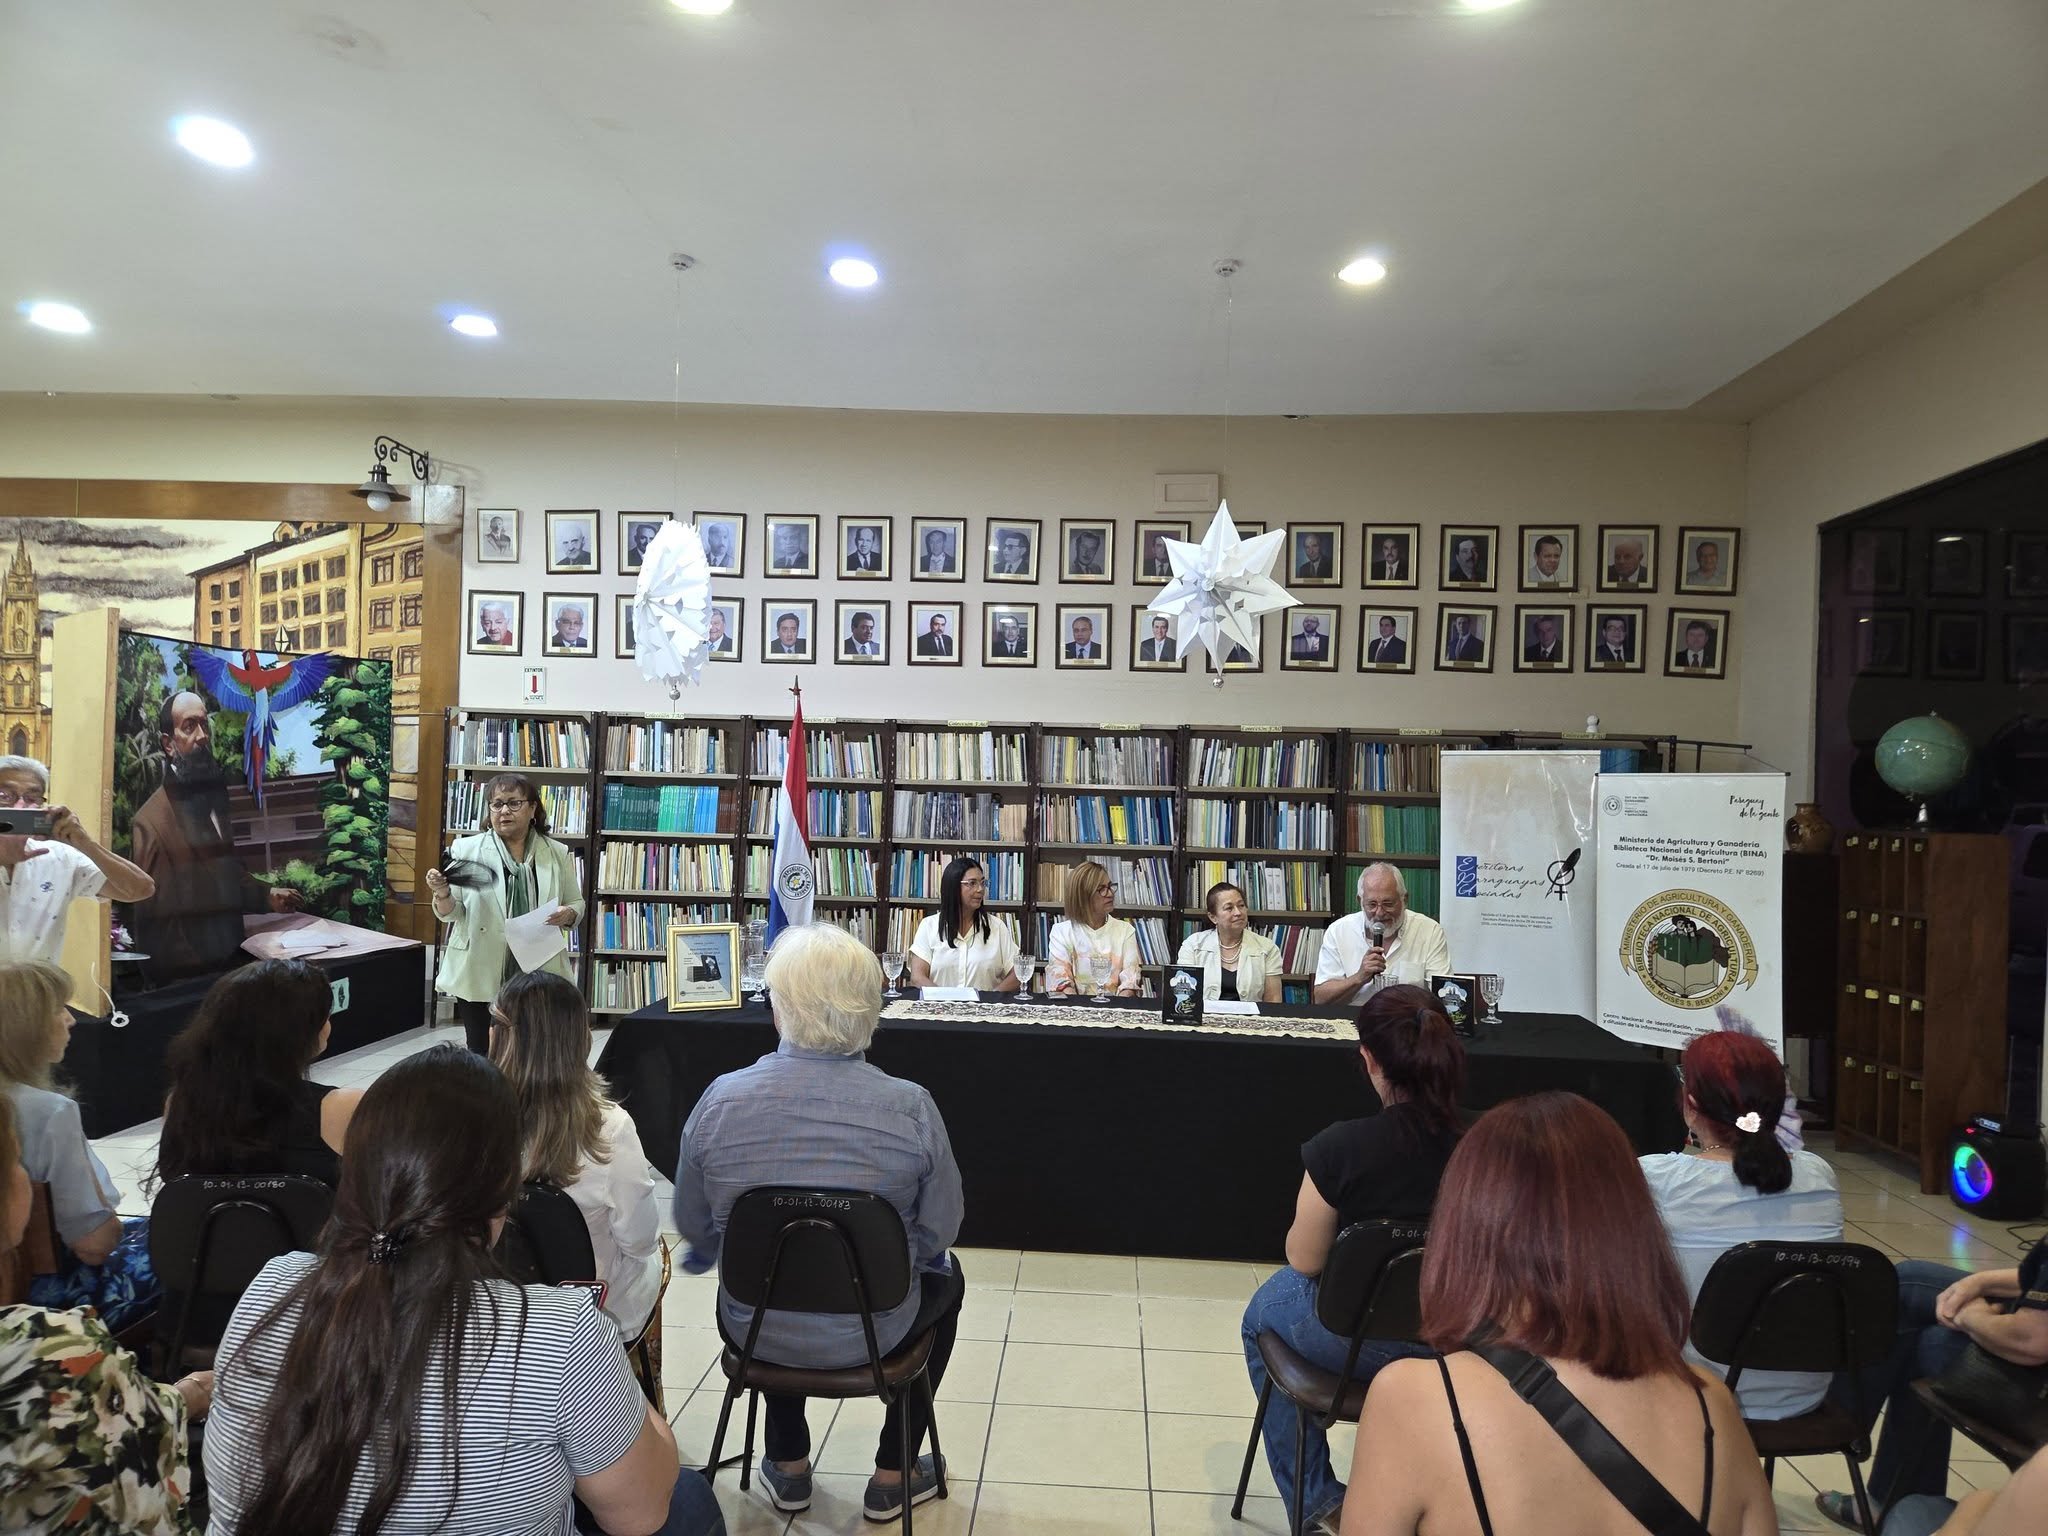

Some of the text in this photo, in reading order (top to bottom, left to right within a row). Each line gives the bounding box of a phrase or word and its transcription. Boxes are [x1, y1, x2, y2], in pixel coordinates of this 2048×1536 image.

[1730, 795, 1764, 810] Paraguay
[1739, 807, 1748, 818] de
[1759, 808, 1780, 821] gente
[1619, 836, 1655, 844] Ministerio
[1667, 838, 1709, 846] Agricultura
[1613, 844, 1648, 852] Biblioteca
[1650, 846, 1682, 854] Nacional
[1695, 848, 1738, 857] Agricultura
[1740, 850, 1767, 859] (BINA)
[1688, 856, 1696, 864] S.
[1660, 864, 1671, 872] julio
[1456, 871, 1546, 890] Paraguayas
[1622, 906, 1647, 951] MINISTERIO
[1647, 899, 1660, 909] DE
[1660, 892, 1721, 912] AGRICULTURA
[1720, 906, 1727, 914] Y
[1635, 906, 1738, 983] BIBLIOTECA NACIONAL DE AGRICULTURA
[1695, 989, 1724, 1007] BERTONI
[1607, 1018, 1627, 1026] difusión
[1640, 1024, 1671, 1033] información
[1621, 1015, 1644, 1023] Nacional
